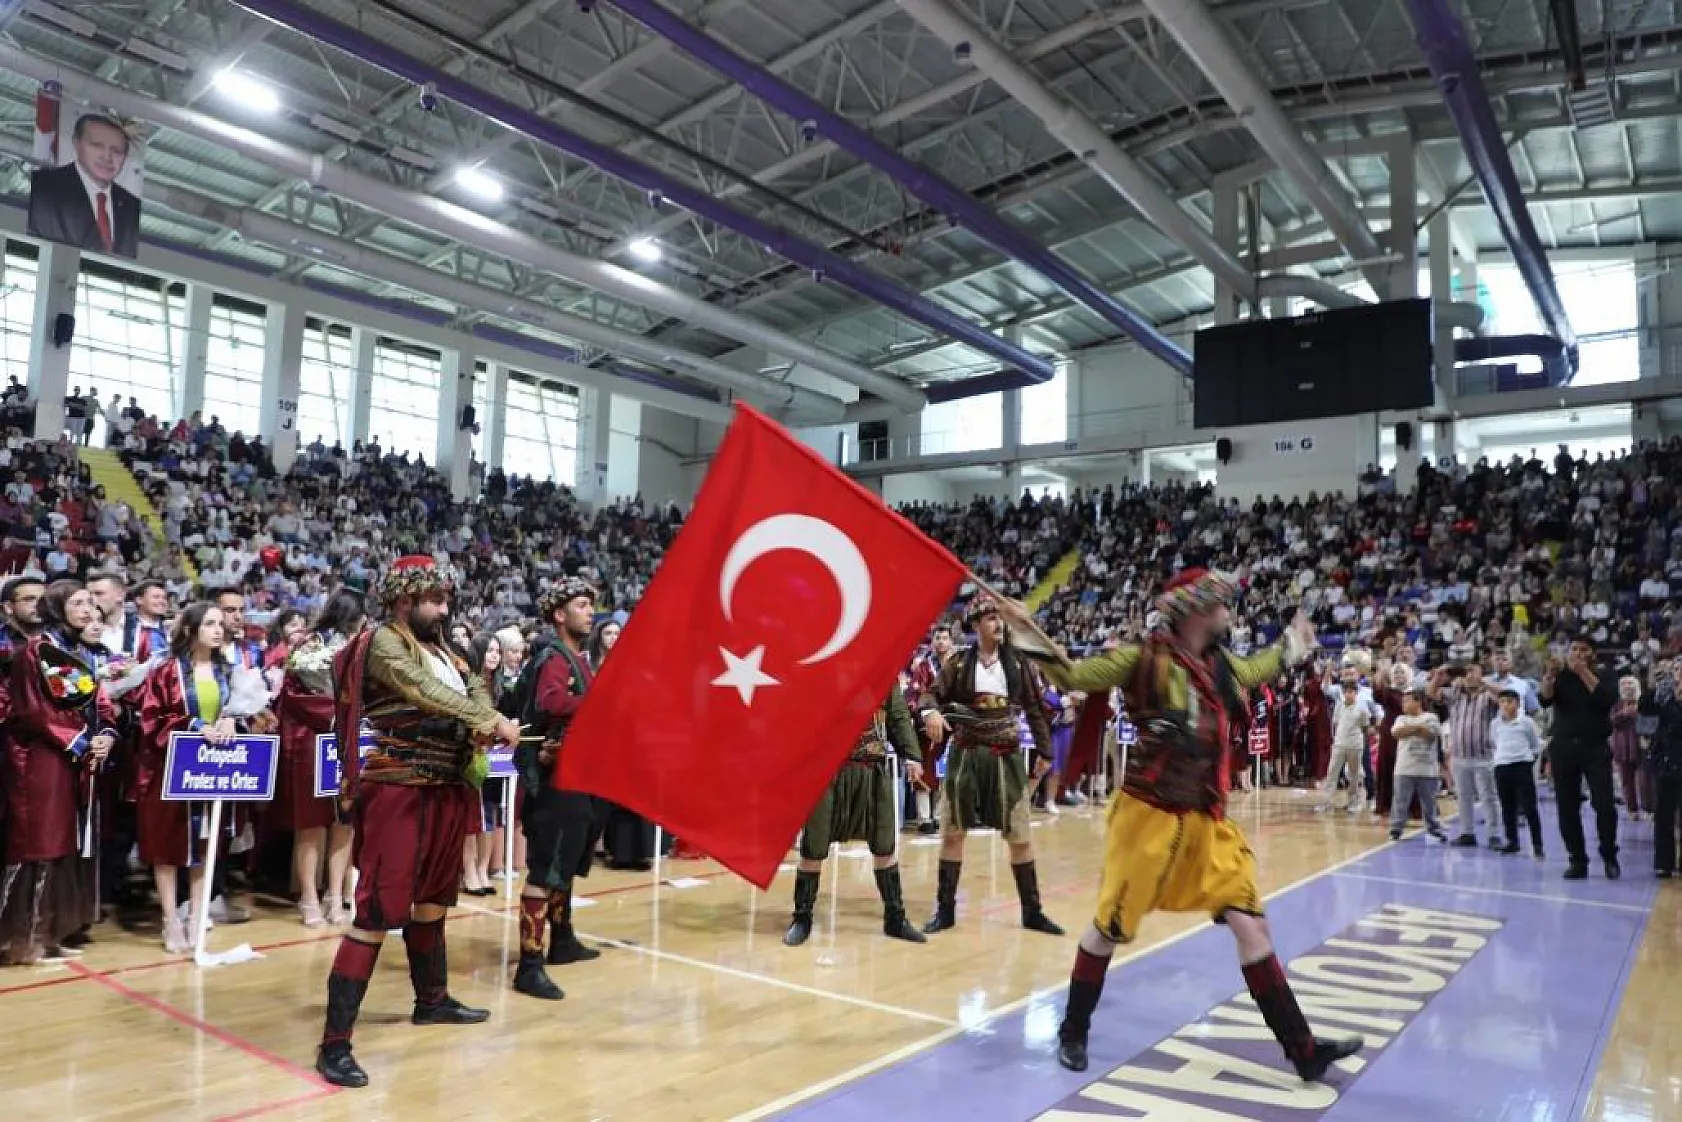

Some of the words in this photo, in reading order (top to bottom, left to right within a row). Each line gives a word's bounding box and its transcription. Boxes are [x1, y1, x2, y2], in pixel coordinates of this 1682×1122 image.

[282, 417, 292, 430] J
[1300, 437, 1313, 450] G
[198, 744, 248, 767] Ortopedik
[182, 769, 216, 790] Protez
[217, 776, 230, 790] ve
[231, 769, 259, 790] Ortez
